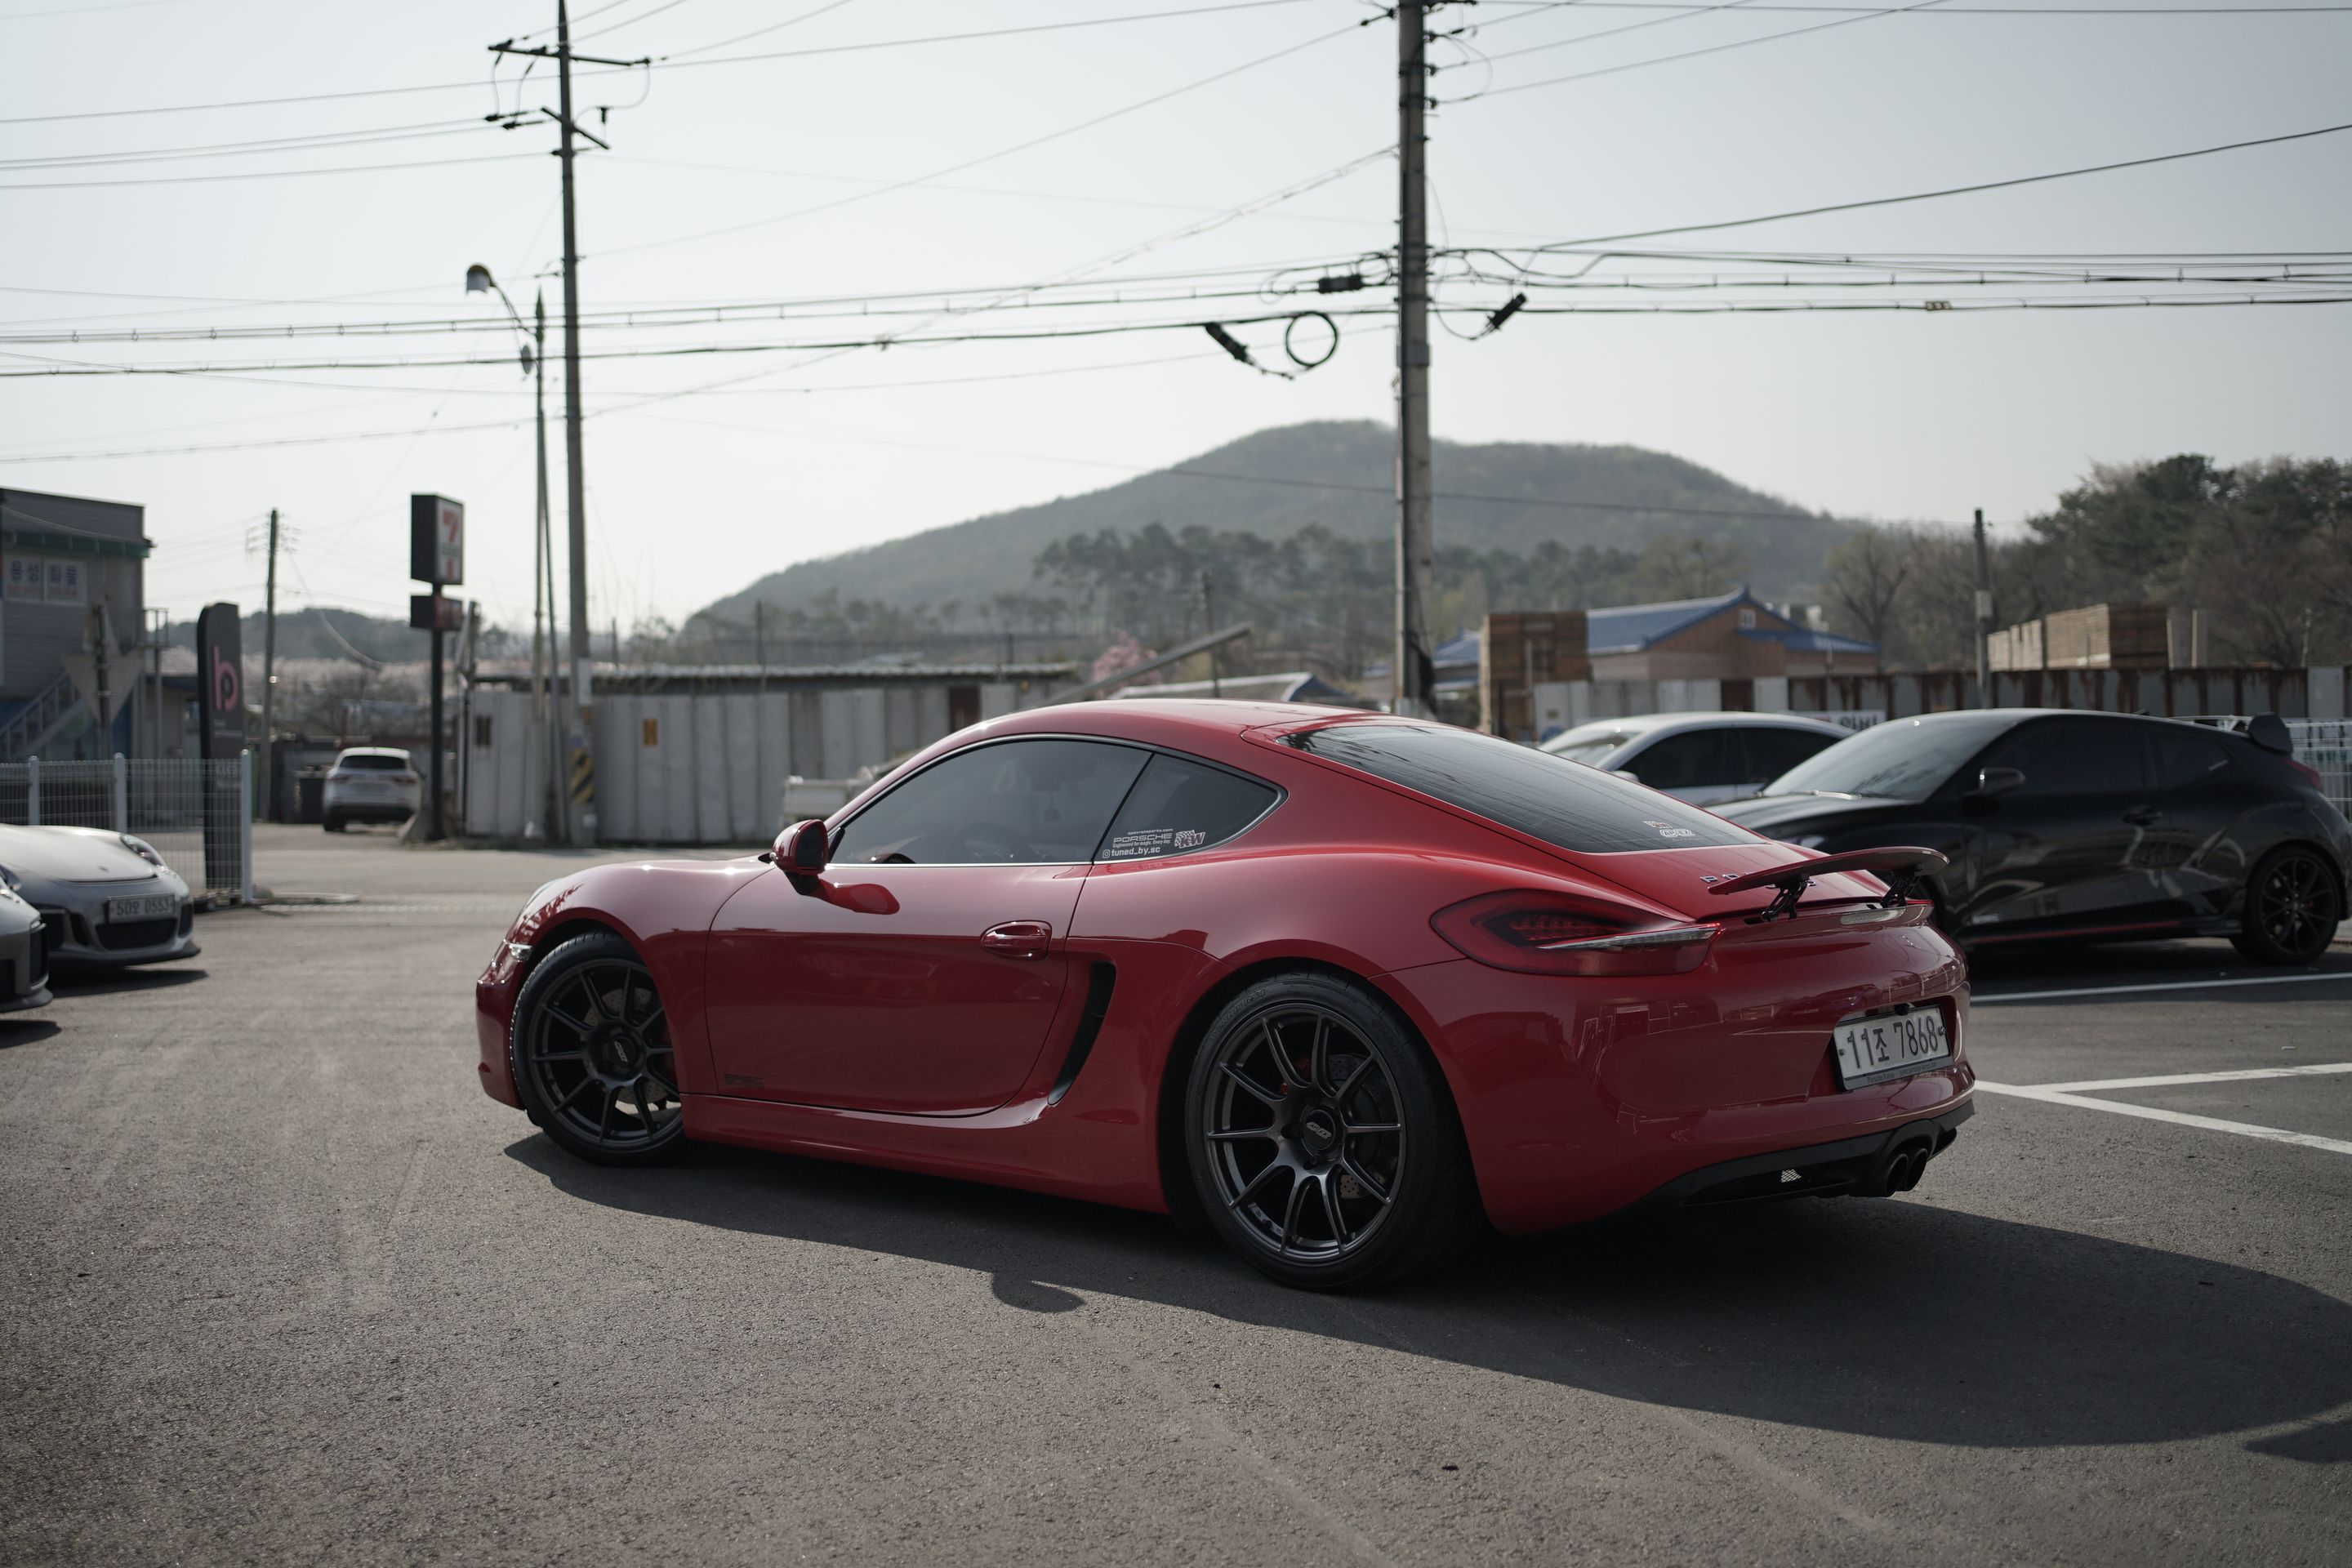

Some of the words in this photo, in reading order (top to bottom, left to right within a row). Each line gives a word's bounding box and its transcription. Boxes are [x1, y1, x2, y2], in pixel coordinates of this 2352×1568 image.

[1113, 833, 1173, 844] PORSCHE
[1180, 831, 1206, 849] KW
[1111, 846, 1161, 857] tuned_by.sc
[1846, 1027, 1890, 1069] 11조
[1893, 1015, 1939, 1059] 7868
